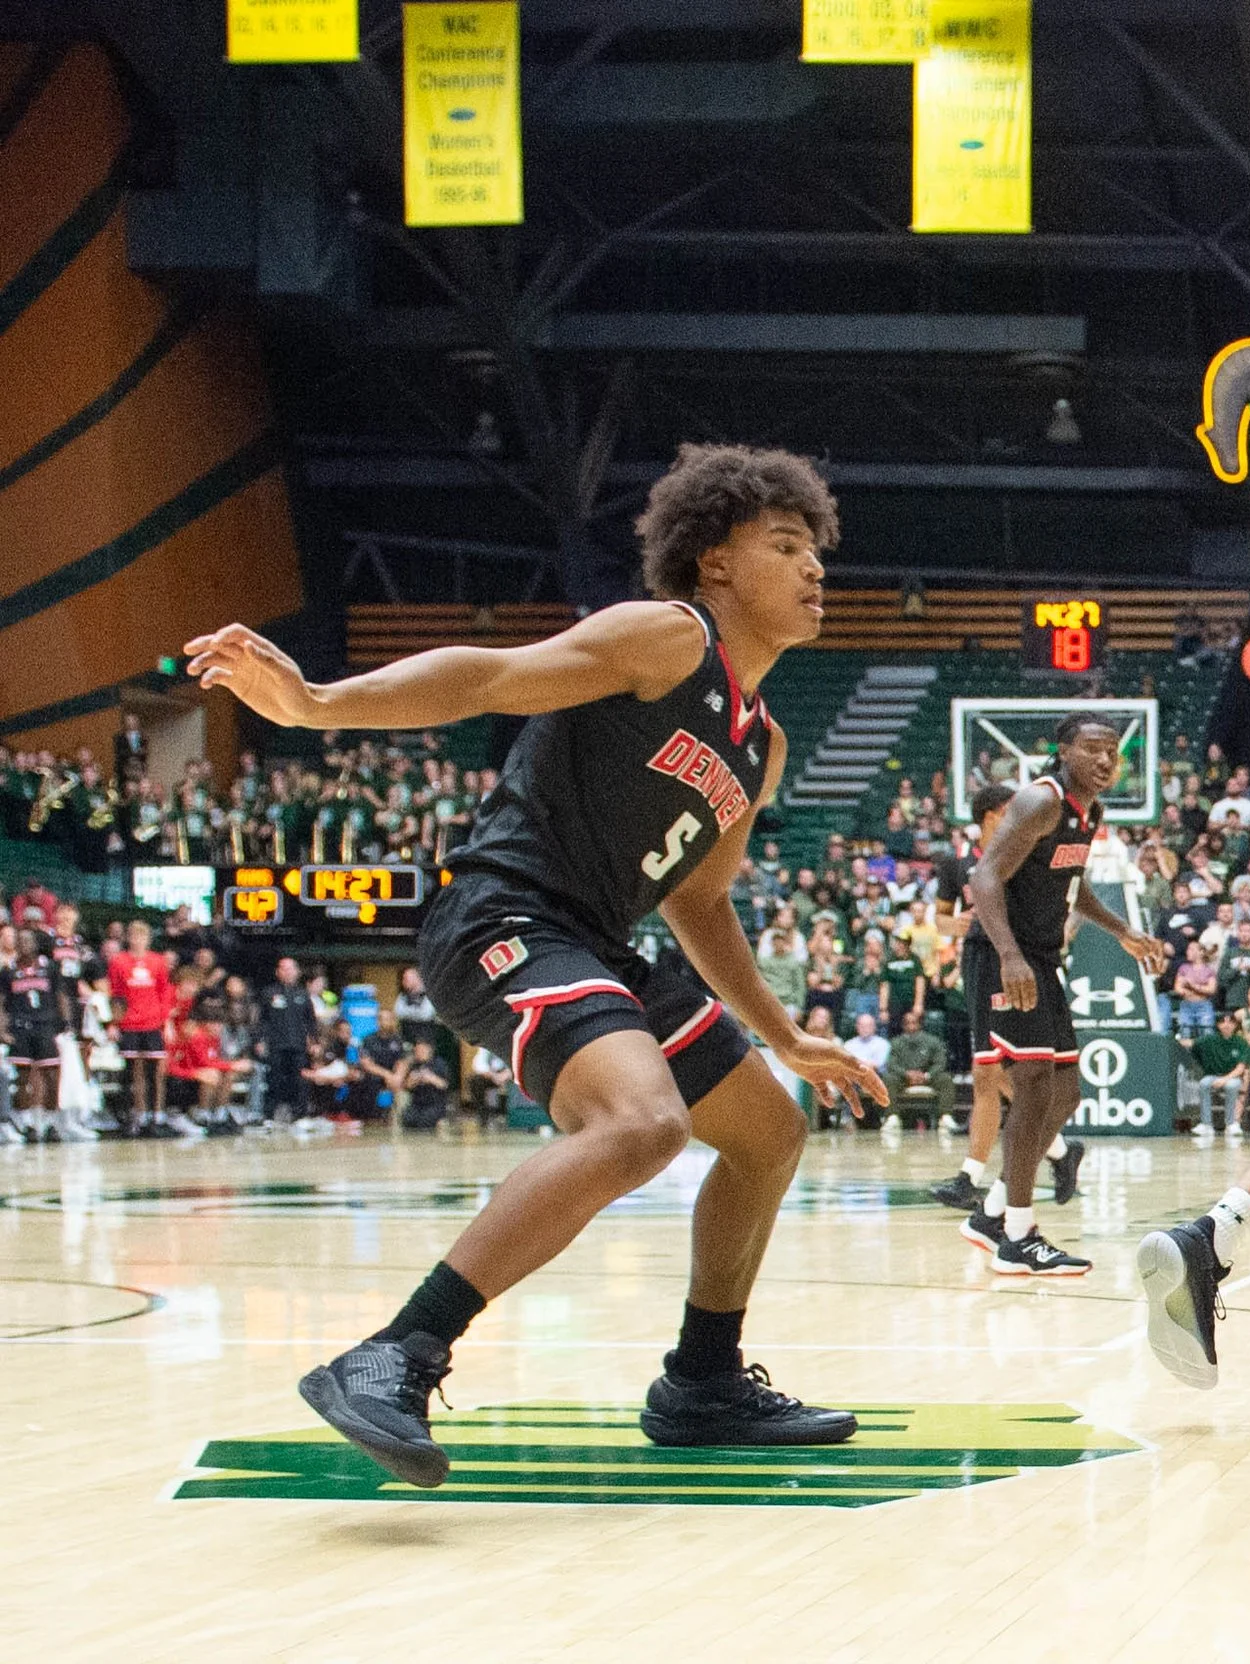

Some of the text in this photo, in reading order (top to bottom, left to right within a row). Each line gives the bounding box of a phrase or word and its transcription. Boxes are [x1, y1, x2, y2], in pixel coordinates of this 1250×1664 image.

[1053, 627, 1090, 672] 18
[640, 811, 702, 881] 5
[314, 869, 392, 902] 14:27
[1066, 1088, 1154, 1127] nbo
